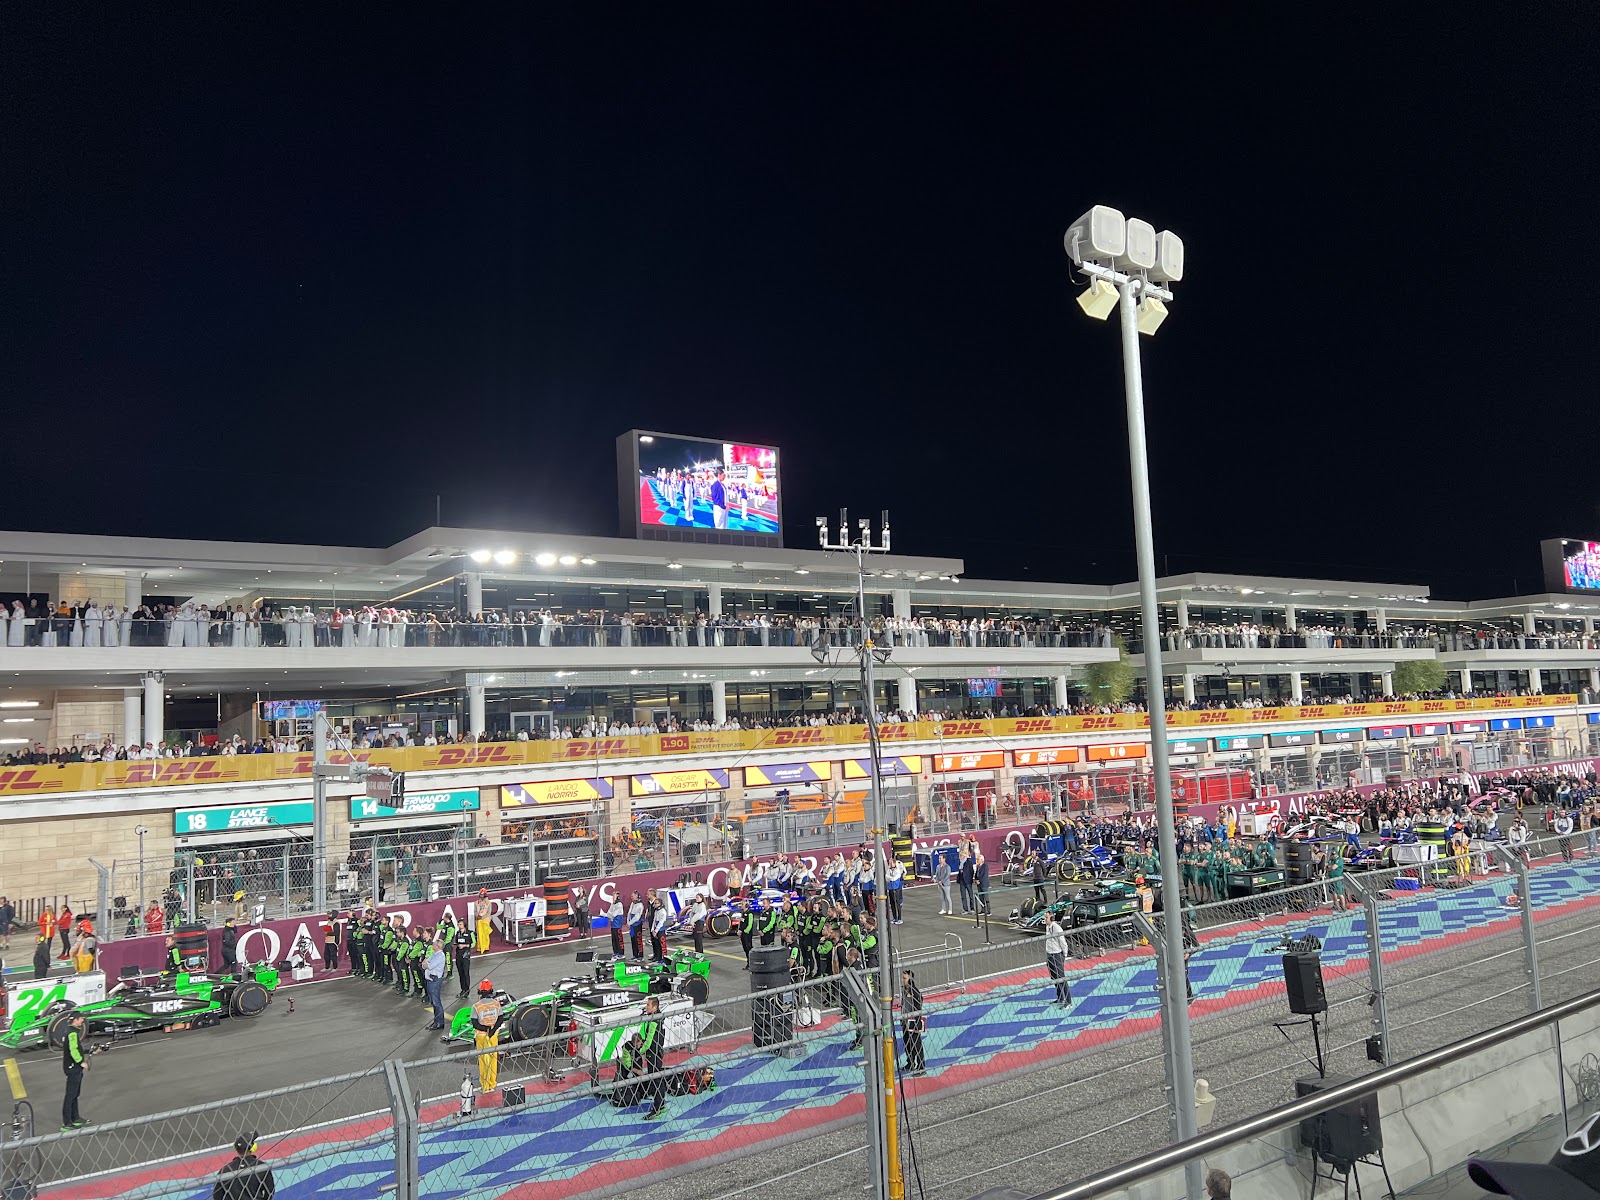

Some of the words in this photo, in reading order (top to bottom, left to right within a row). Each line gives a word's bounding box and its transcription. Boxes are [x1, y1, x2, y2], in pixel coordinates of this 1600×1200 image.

[1344, 706, 1367, 715] DHL
[1385, 704, 1407, 713] DHL
[1424, 702, 1444, 711] DHL
[1200, 712, 1229, 723] DHL
[1252, 710, 1278, 720] DHL
[1300, 708, 1324, 718] DHL
[1082, 717, 1117, 728] DHL
[1144, 715, 1175, 725] DL
[942, 722, 984, 735] DHL
[1015, 720, 1053, 732] DHL
[775, 730, 824, 744] DHL
[564, 739, 630, 757] DHL
[437, 746, 511, 765] DHL
[124, 761, 222, 783] DHL
[671, 773, 697, 782] OSCAR
[548, 783, 578, 792] LANDO
[669, 781, 699, 789] PIASTRI
[403, 794, 450, 805] ERNANDO
[546, 790, 579, 799] NORRIS
[230, 808, 268, 819] LANCE
[361, 801, 378, 815] 14
[188, 813, 206, 830] 18
[227, 816, 269, 828] STROLL
[625, 965, 642, 974] KICK
[189, 975, 208, 984] KICK
[12, 984, 68, 1018] 24
[602, 992, 630, 1006] KICK
[152, 999, 183, 1013] KICK
[672, 1020, 687, 1028] zero
